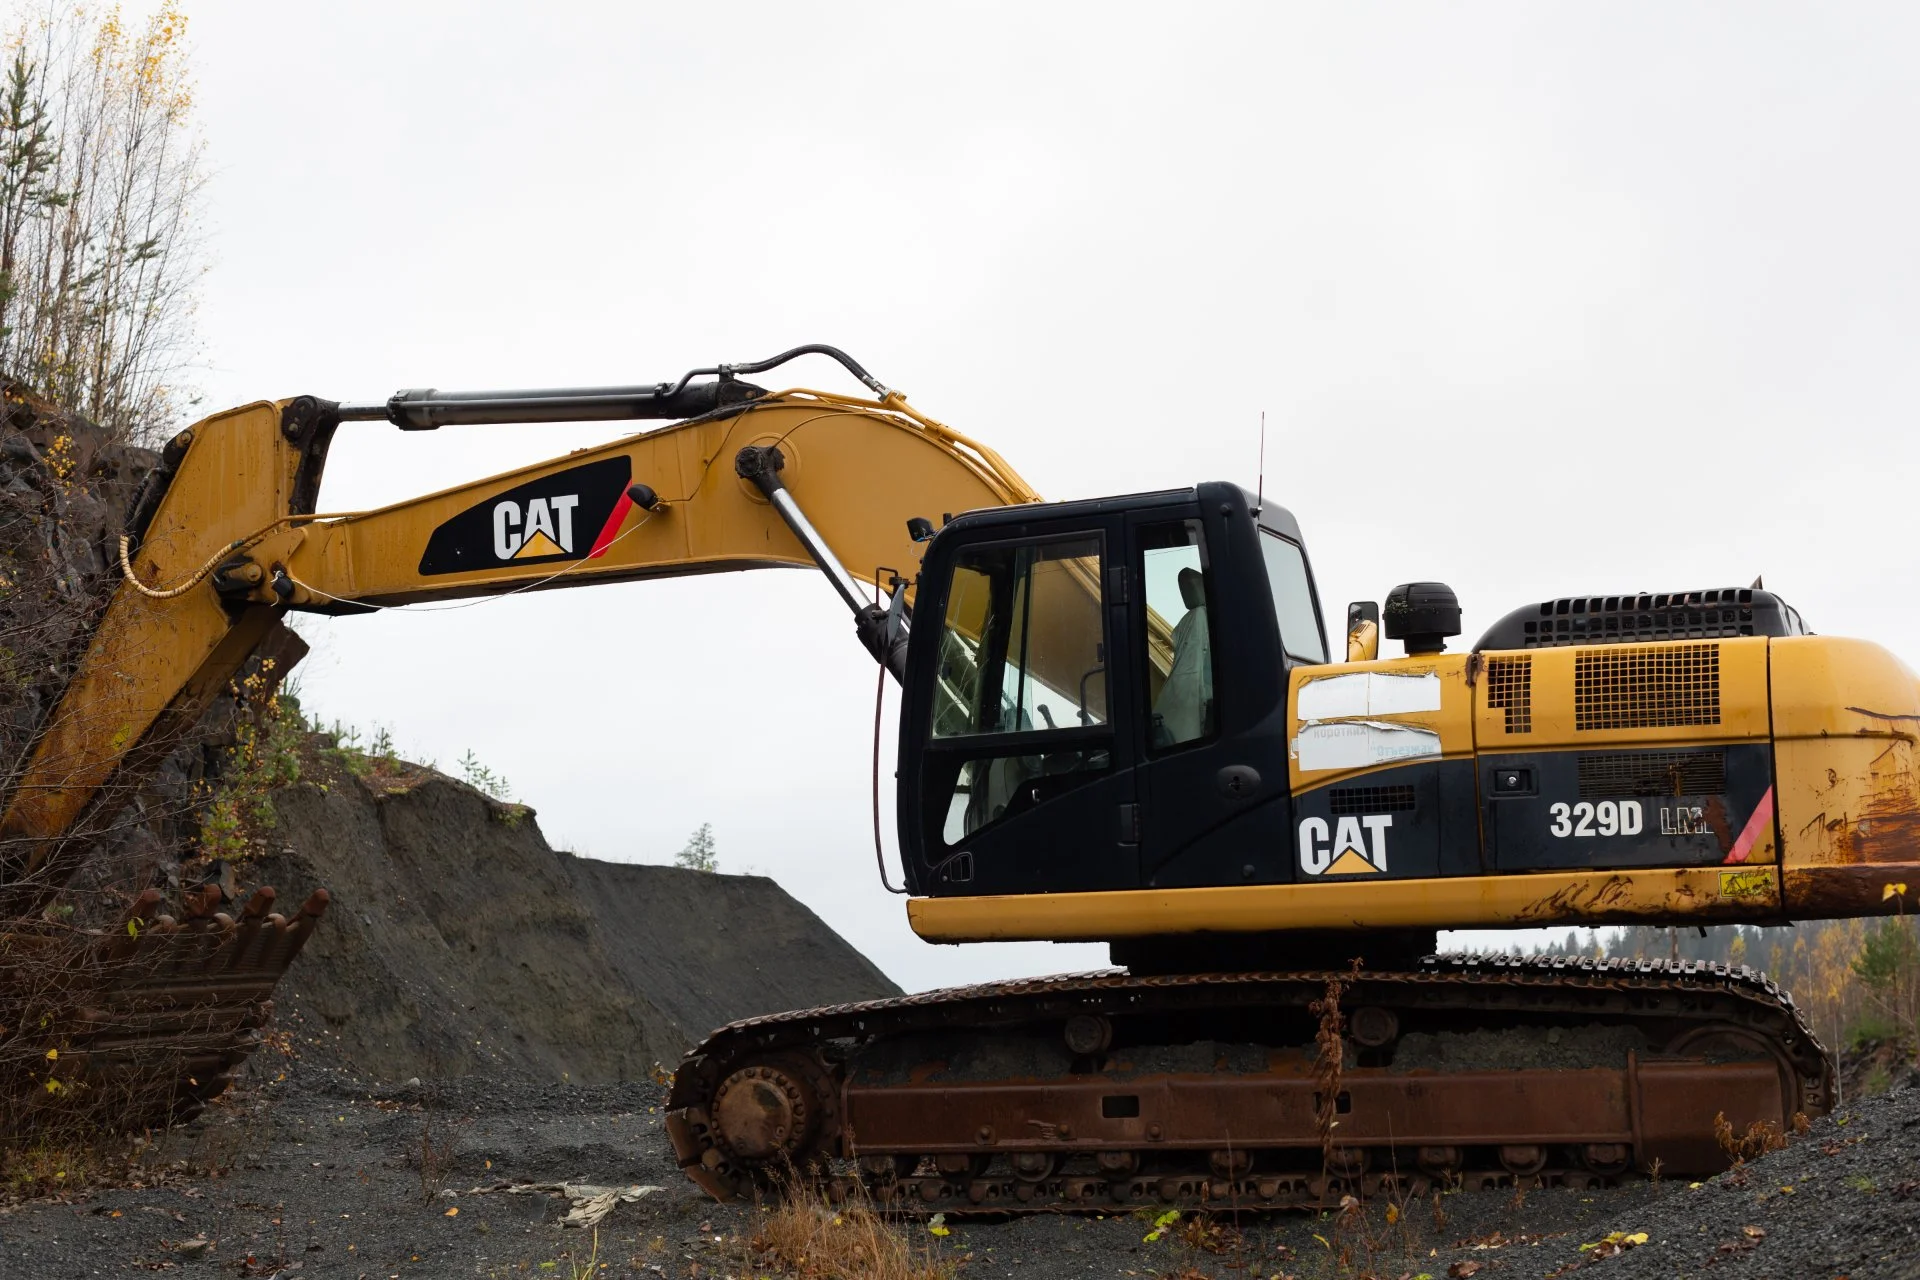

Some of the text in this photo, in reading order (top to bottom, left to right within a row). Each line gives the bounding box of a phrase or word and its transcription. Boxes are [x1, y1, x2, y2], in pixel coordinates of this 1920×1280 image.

[494, 494, 579, 560] CAT
[1299, 815, 1392, 875] CAT
[1550, 801, 1642, 837] 329D
